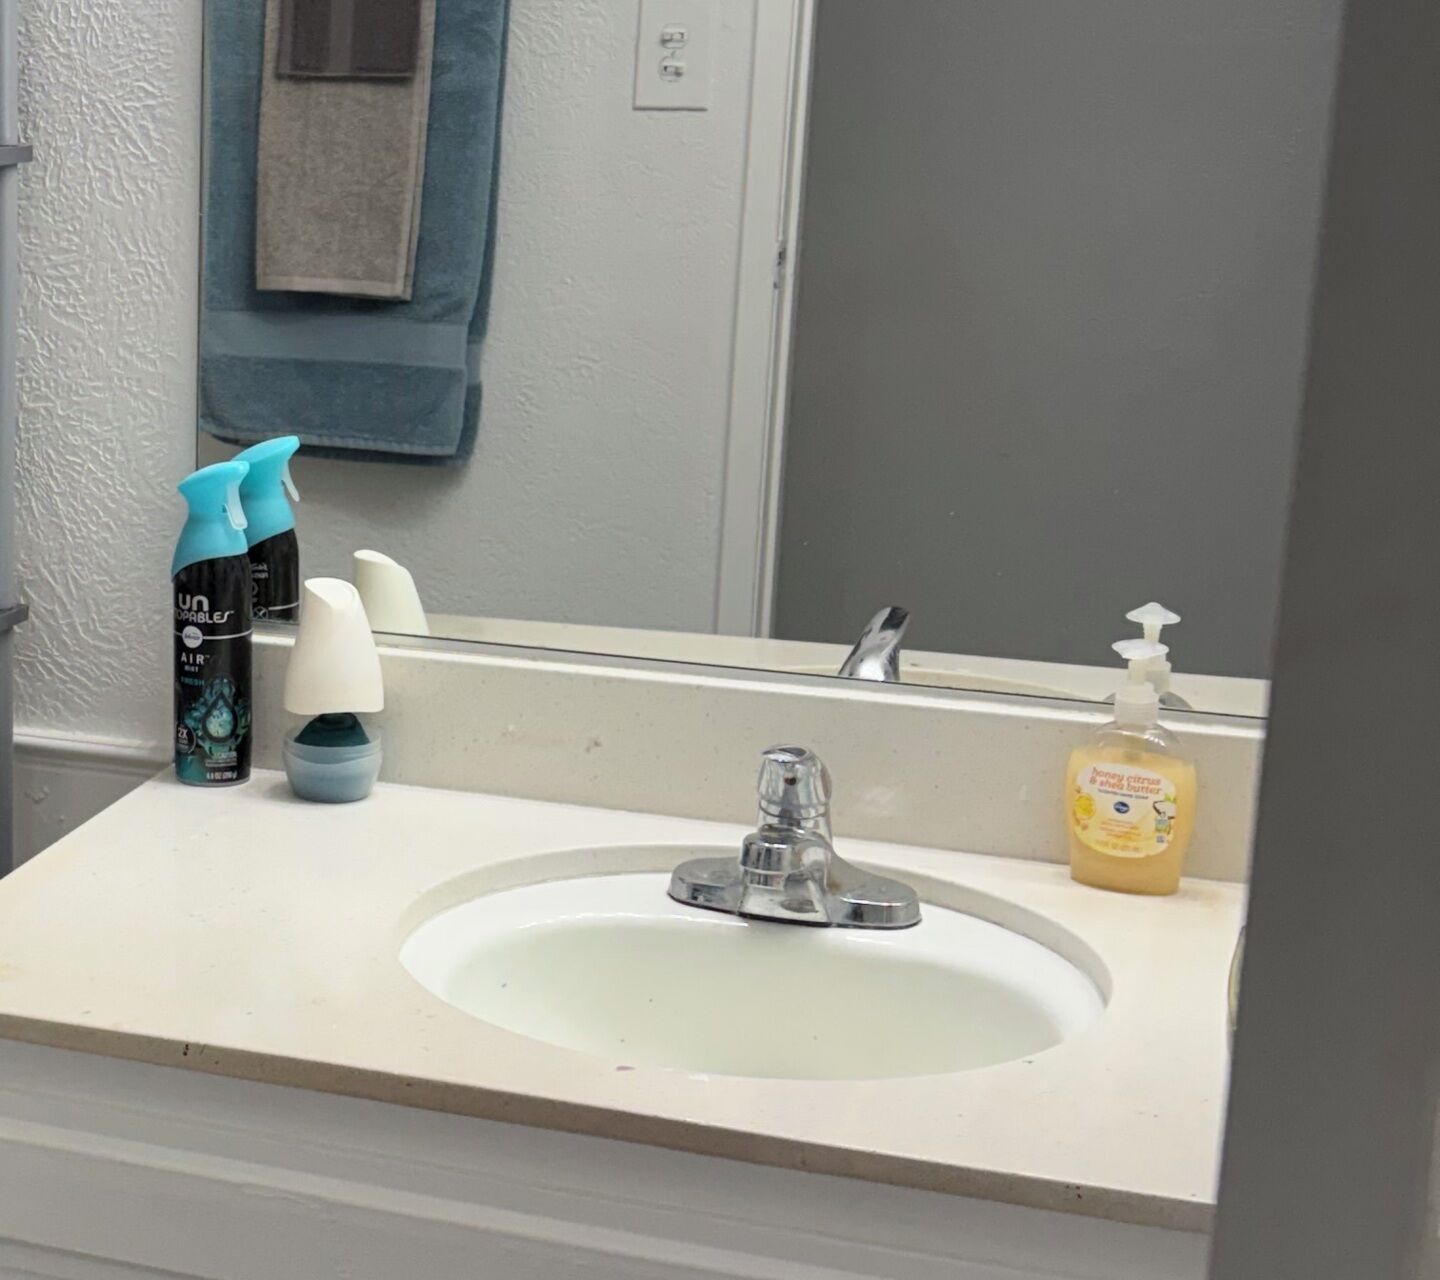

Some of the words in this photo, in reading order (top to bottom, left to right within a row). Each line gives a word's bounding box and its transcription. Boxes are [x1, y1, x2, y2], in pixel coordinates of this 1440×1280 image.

[181, 652, 205, 665] AIR
[1092, 766, 1125, 783] honey
[1127, 774, 1162, 786] citrus
[1099, 779, 1125, 790] shea
[1126, 782, 1163, 795] butter
